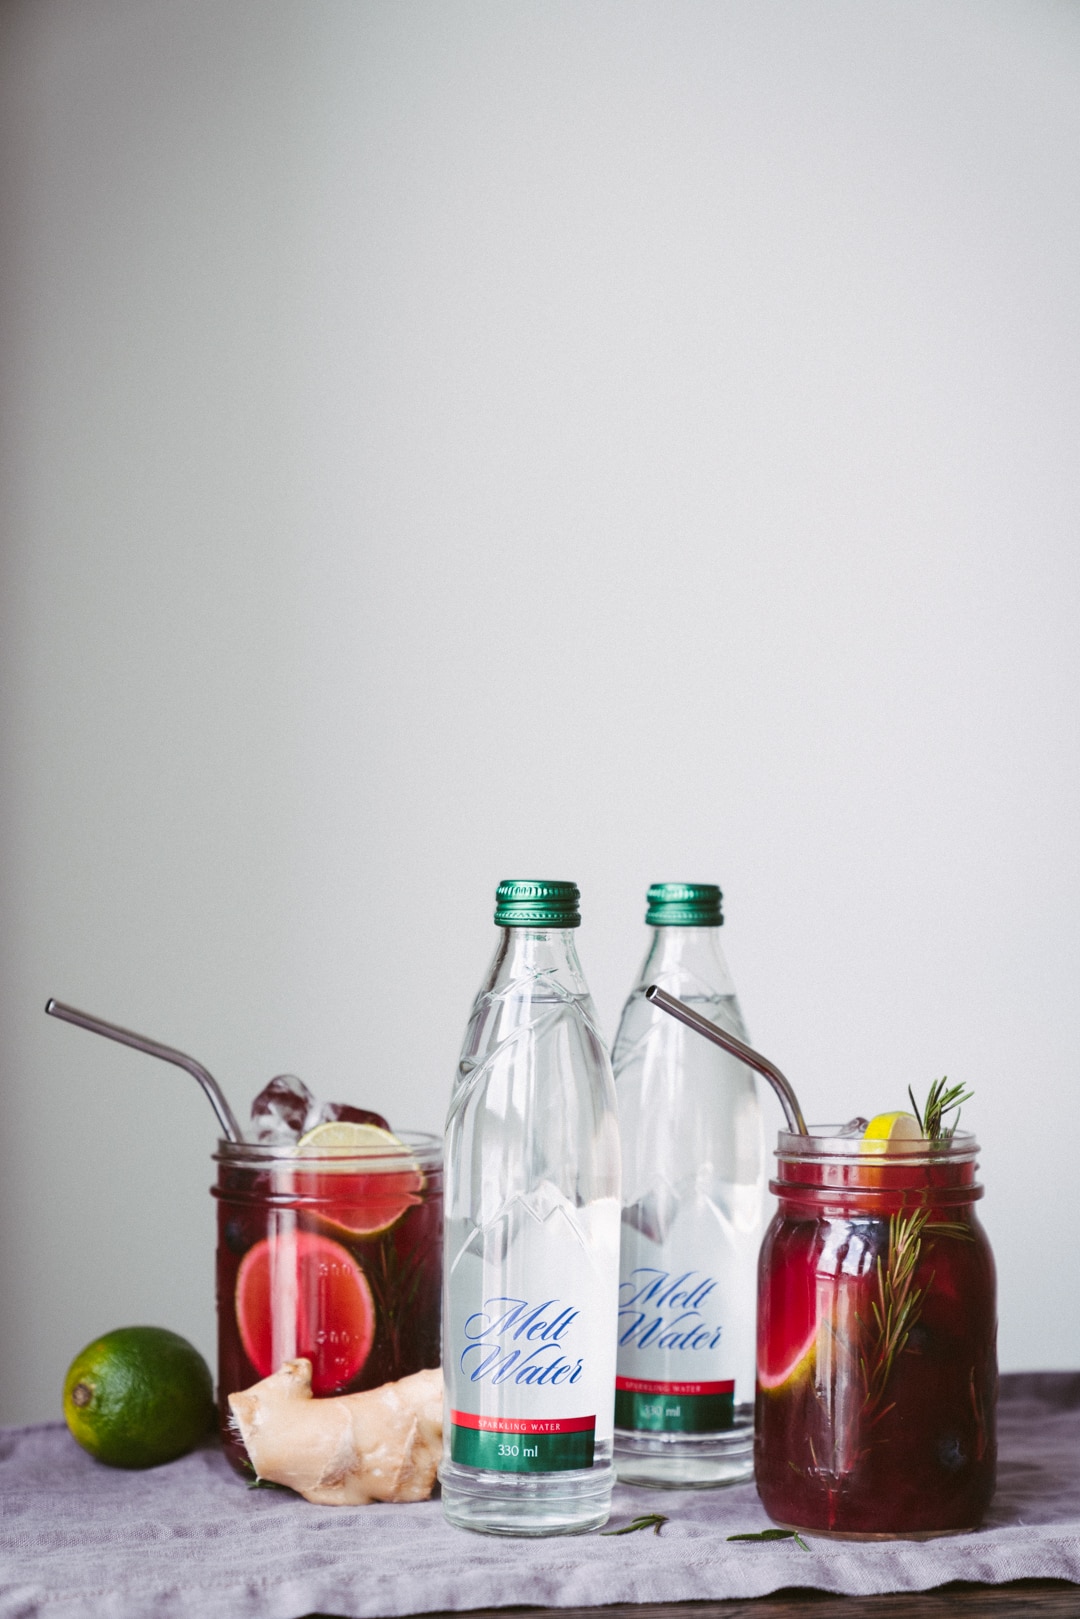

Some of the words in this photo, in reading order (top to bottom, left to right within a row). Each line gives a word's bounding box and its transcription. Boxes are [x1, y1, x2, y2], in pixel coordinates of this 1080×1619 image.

[619, 1268, 719, 1308] Melt
[464, 1297, 580, 1342] Melt
[618, 1310, 722, 1351] Water
[460, 1343, 584, 1386] Water
[625, 1381, 670, 1393] SPARKLING
[672, 1384, 701, 1393] WATER
[644, 1404, 663, 1417] 330
[665, 1405, 681, 1417] ml
[478, 1419, 527, 1432] SPARKLING
[530, 1421, 561, 1432] WATER
[497, 1443, 520, 1458] 330
[523, 1444, 538, 1458] ml
